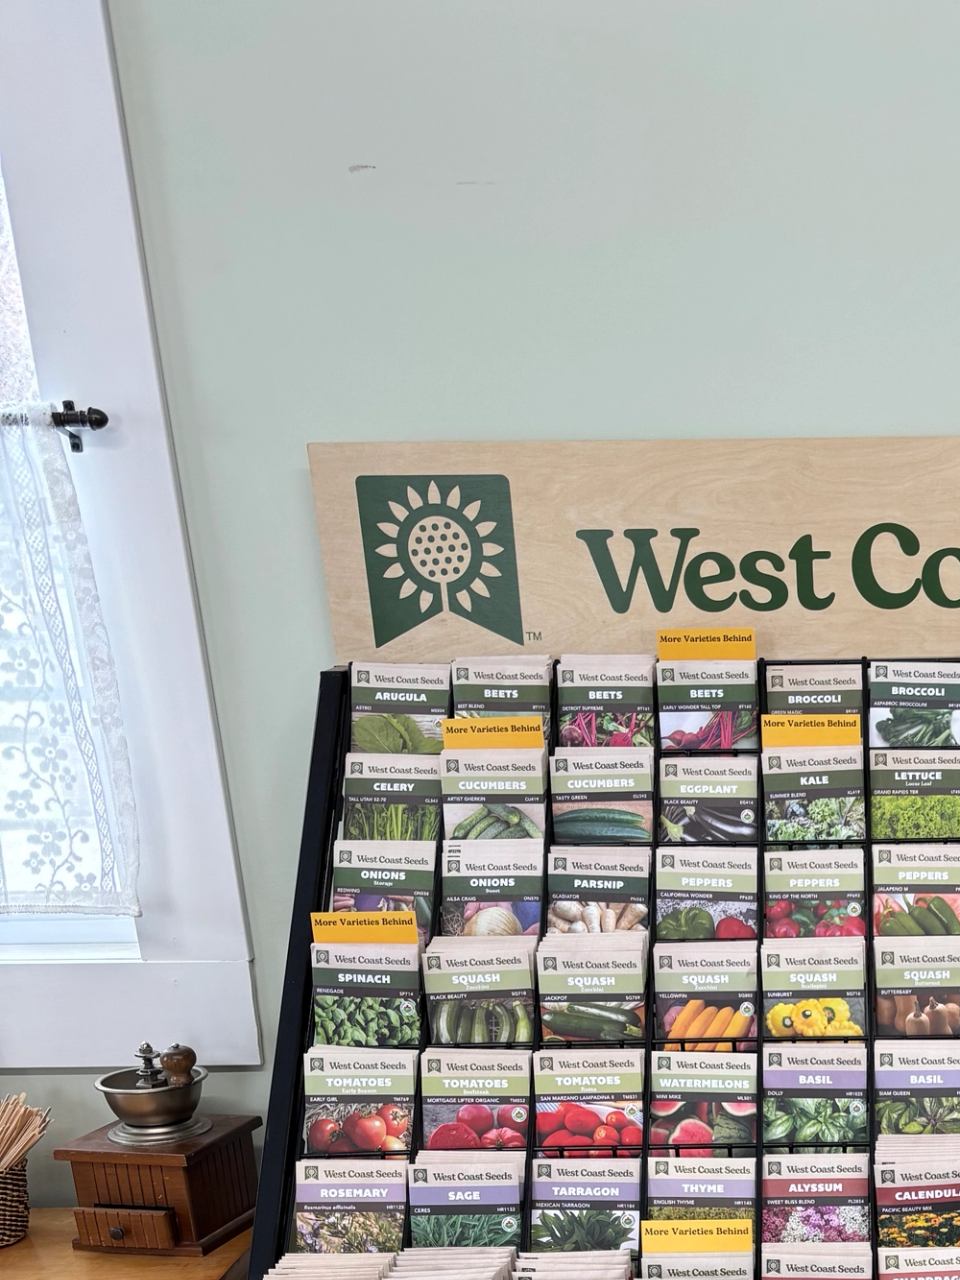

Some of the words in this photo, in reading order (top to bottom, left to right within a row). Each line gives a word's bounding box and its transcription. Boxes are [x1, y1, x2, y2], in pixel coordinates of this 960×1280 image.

[576, 528, 835, 614] West
[589, 691, 623, 699] BEETS
[690, 689, 724, 698] BEETS
[892, 686, 945, 696] BROCCOLI
[375, 692, 427, 702] ARUGULA
[568, 779, 635, 788] CUCUMBERS
[800, 776, 829, 785] KALE
[373, 783, 414, 791] CELERY
[459, 781, 526, 790] CUCUMBERS
[680, 785, 738, 793] EGGPLANT
[361, 870, 406, 880] ONIONS
[574, 879, 624, 889] PARSNIP
[682, 877, 733, 887] PEPPERS
[338, 973, 390, 984] SPINACH
[452, 974, 500, 985] SQUASH
[790, 973, 837, 984] SQUASH
[904, 970, 950, 982] SQUASH
[326, 1078, 392, 1087] TOMATOES
[555, 1076, 621, 1086] TOMATOES
[660, 1079, 749, 1089] WATERMELONS
[799, 1075, 832, 1084] BASIL
[552, 1187, 619, 1196] TARRAGON
[682, 1184, 724, 1193] THYME
[789, 1183, 842, 1192] ALYSSUM
[320, 1188, 388, 1197] ROSEMARY
[448, 1191, 480, 1200] SAGE
[645, 1228, 668, 1236] More
[672, 1227, 714, 1235] Varieties
[716, 1227, 749, 1235] Behind
